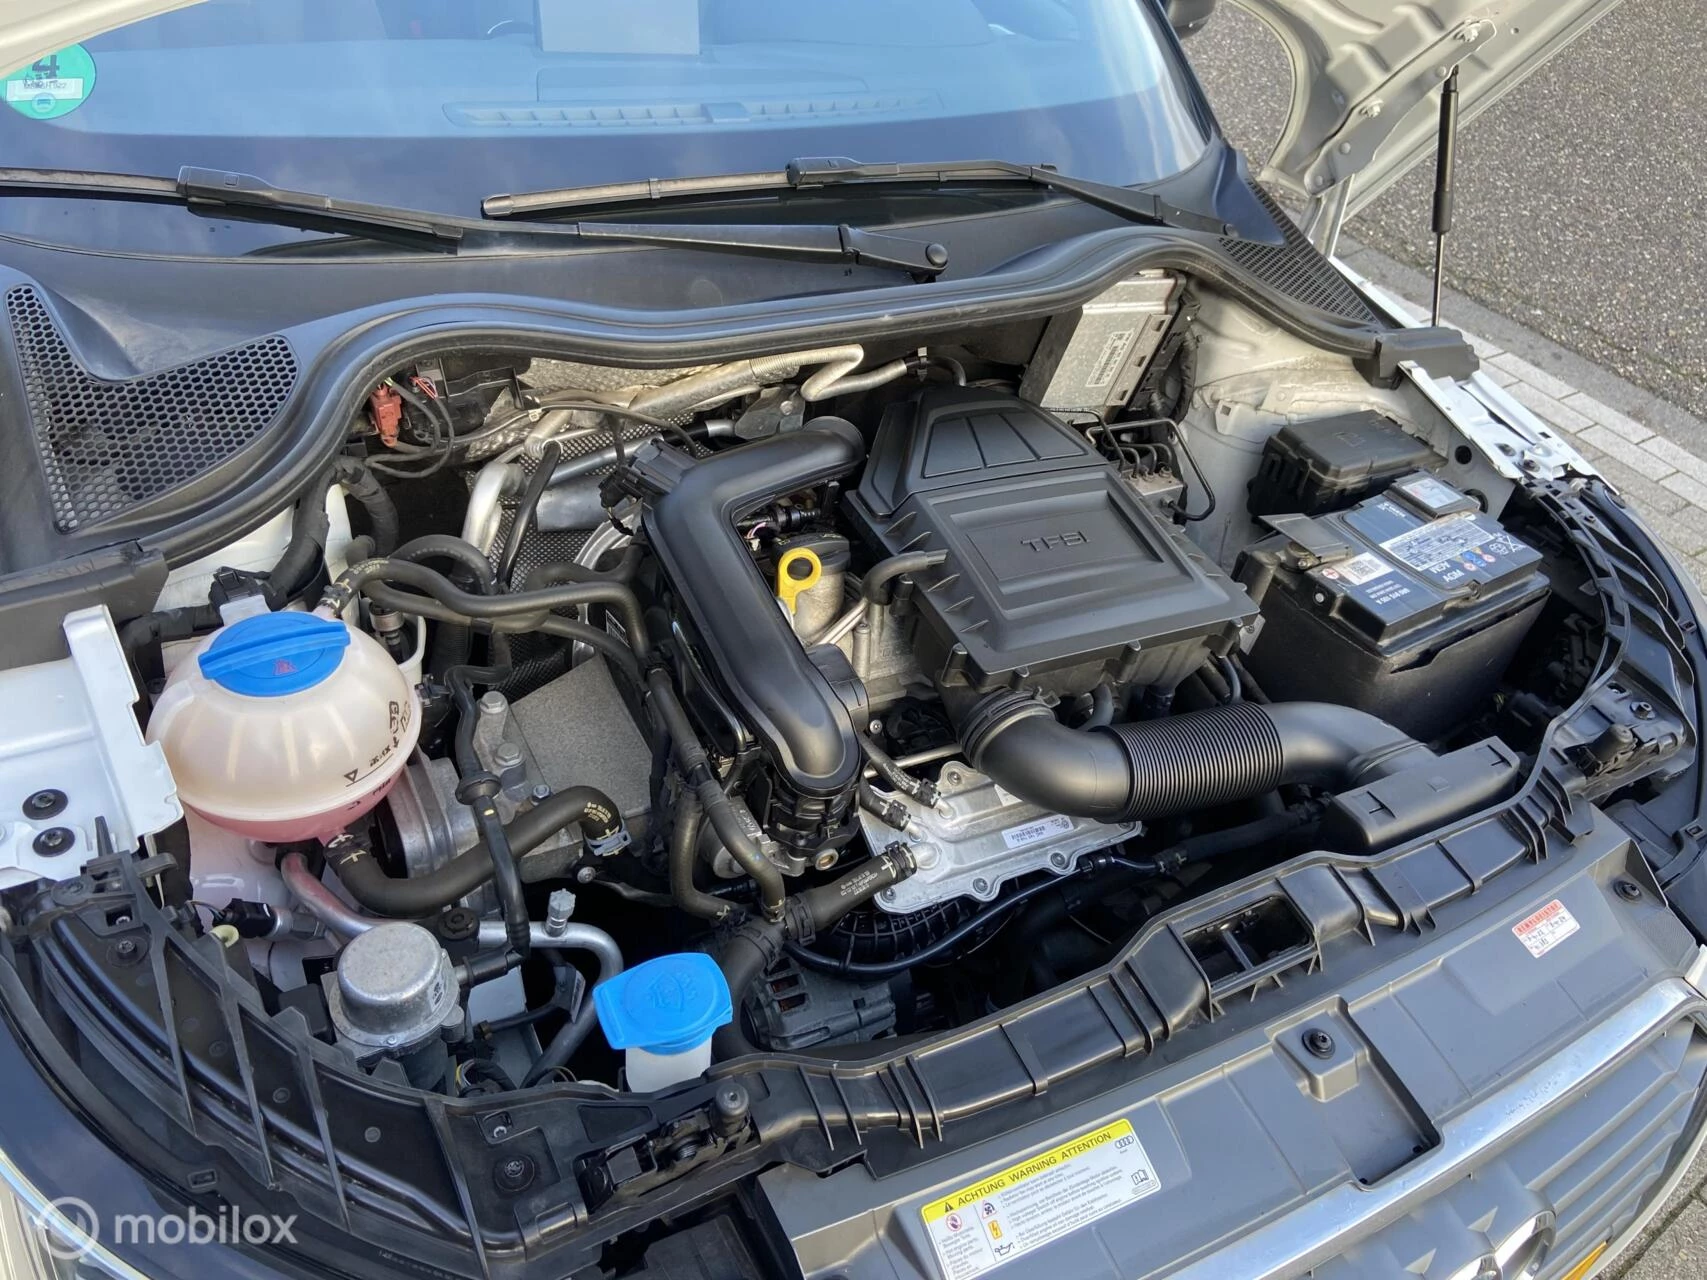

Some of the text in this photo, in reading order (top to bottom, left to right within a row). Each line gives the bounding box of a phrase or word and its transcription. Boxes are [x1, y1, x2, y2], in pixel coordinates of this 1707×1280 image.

[1020, 531, 1089, 552] TFSI
[958, 1178, 1006, 1206] ACHTUNG
[1009, 1156, 1057, 1182] WARNING
[1061, 1131, 1112, 1160] ATTENTION
